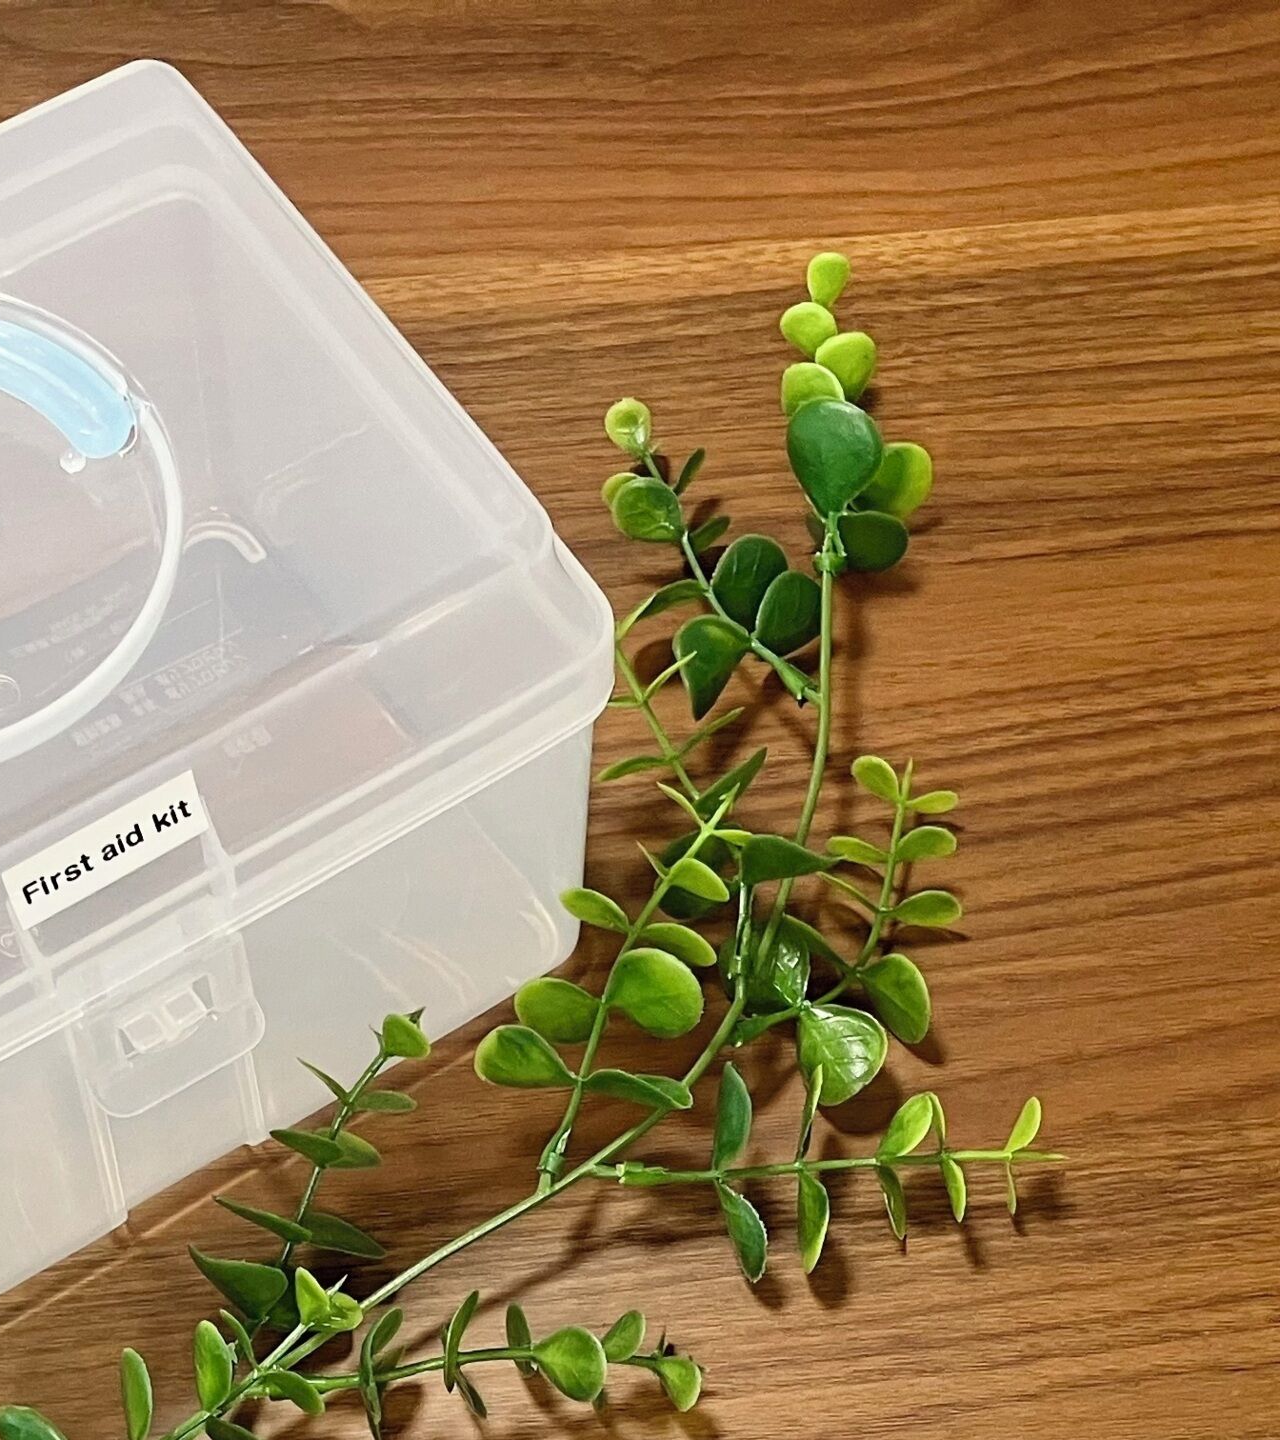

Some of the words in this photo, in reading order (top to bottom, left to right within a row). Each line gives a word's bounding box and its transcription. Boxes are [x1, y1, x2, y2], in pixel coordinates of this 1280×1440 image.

[21, 853, 95, 905] First
[101, 823, 144, 862] aid
[151, 799, 193, 833] kit
